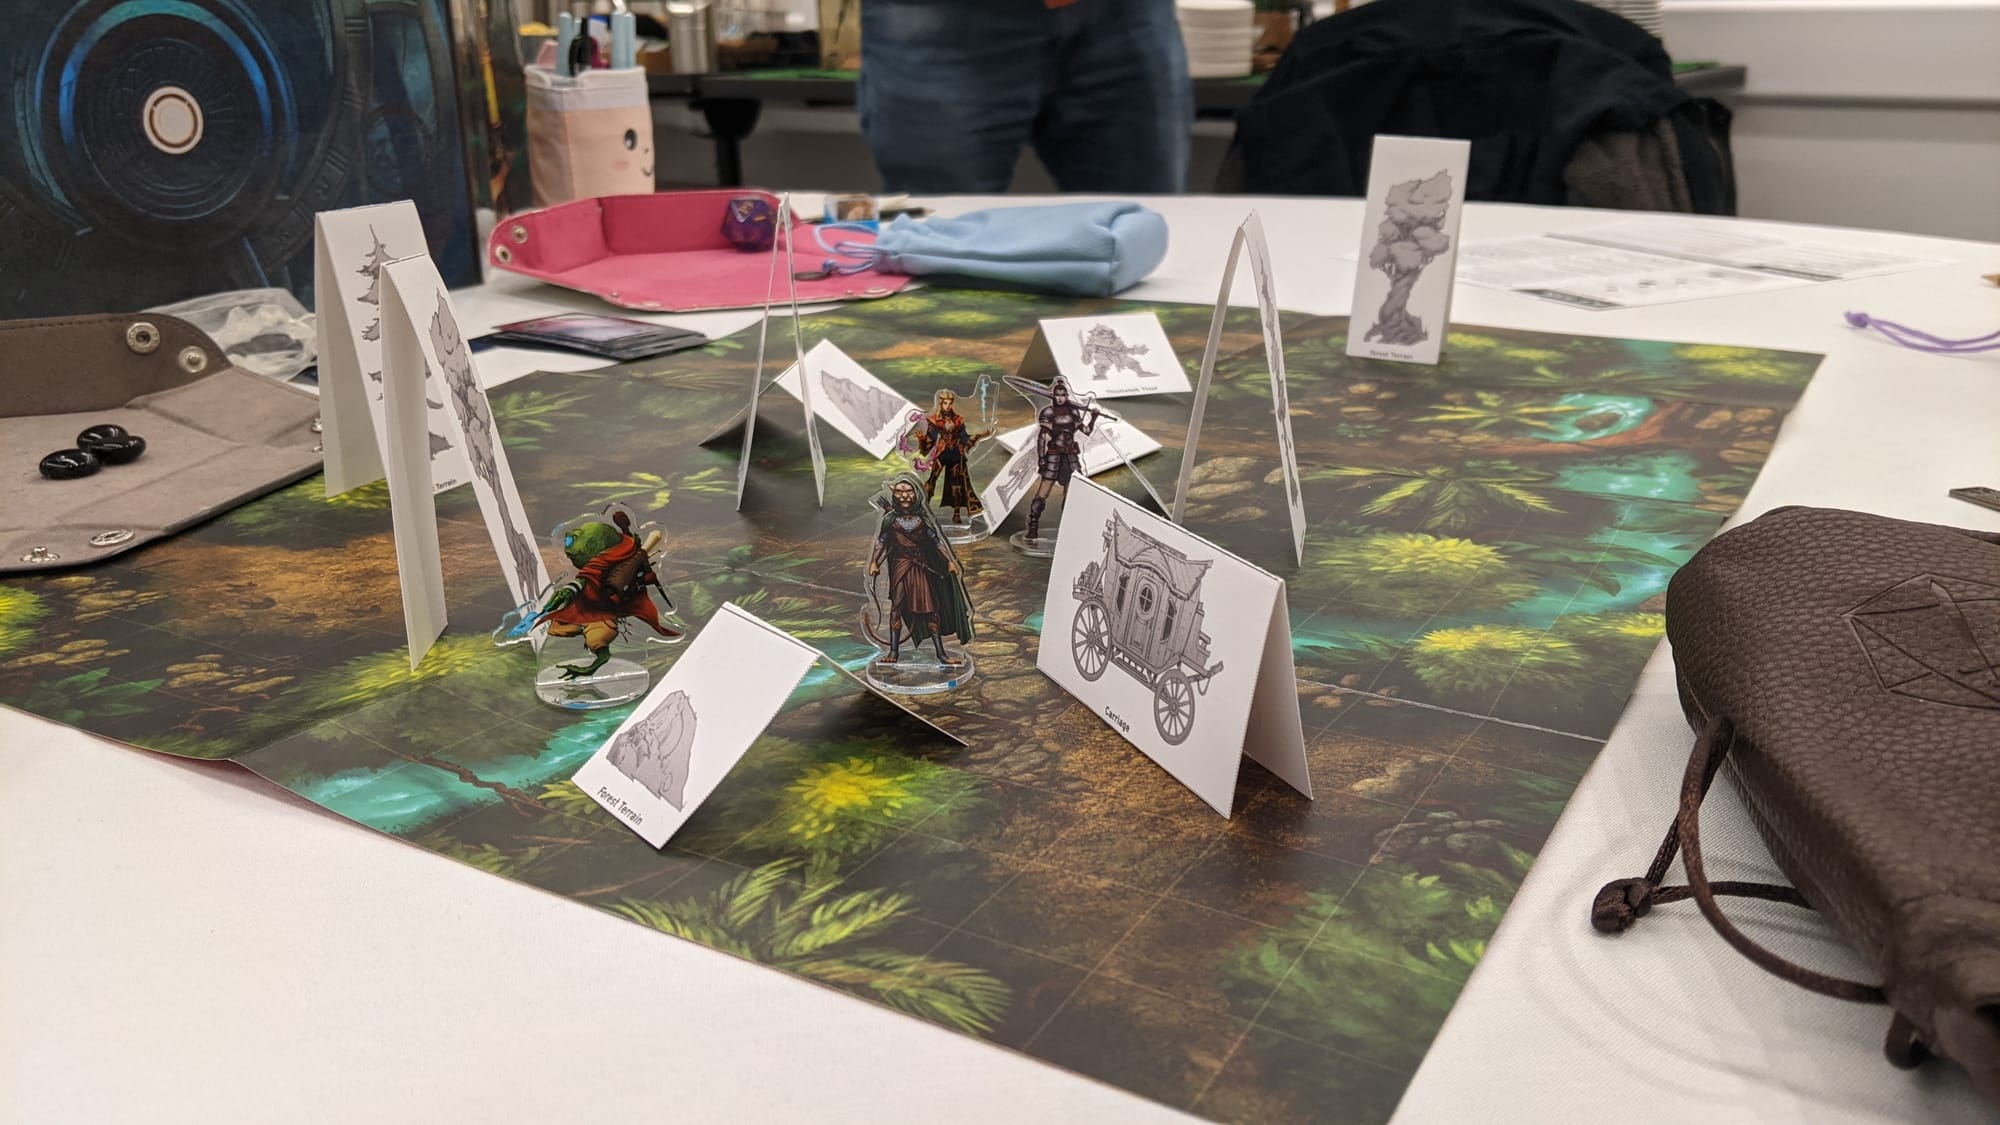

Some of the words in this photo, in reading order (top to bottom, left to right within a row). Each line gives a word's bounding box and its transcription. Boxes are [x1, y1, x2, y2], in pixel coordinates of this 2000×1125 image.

[1105, 705, 1130, 733] Carriage
[597, 786, 621, 808] Forest
[617, 800, 643, 826] Terrain
